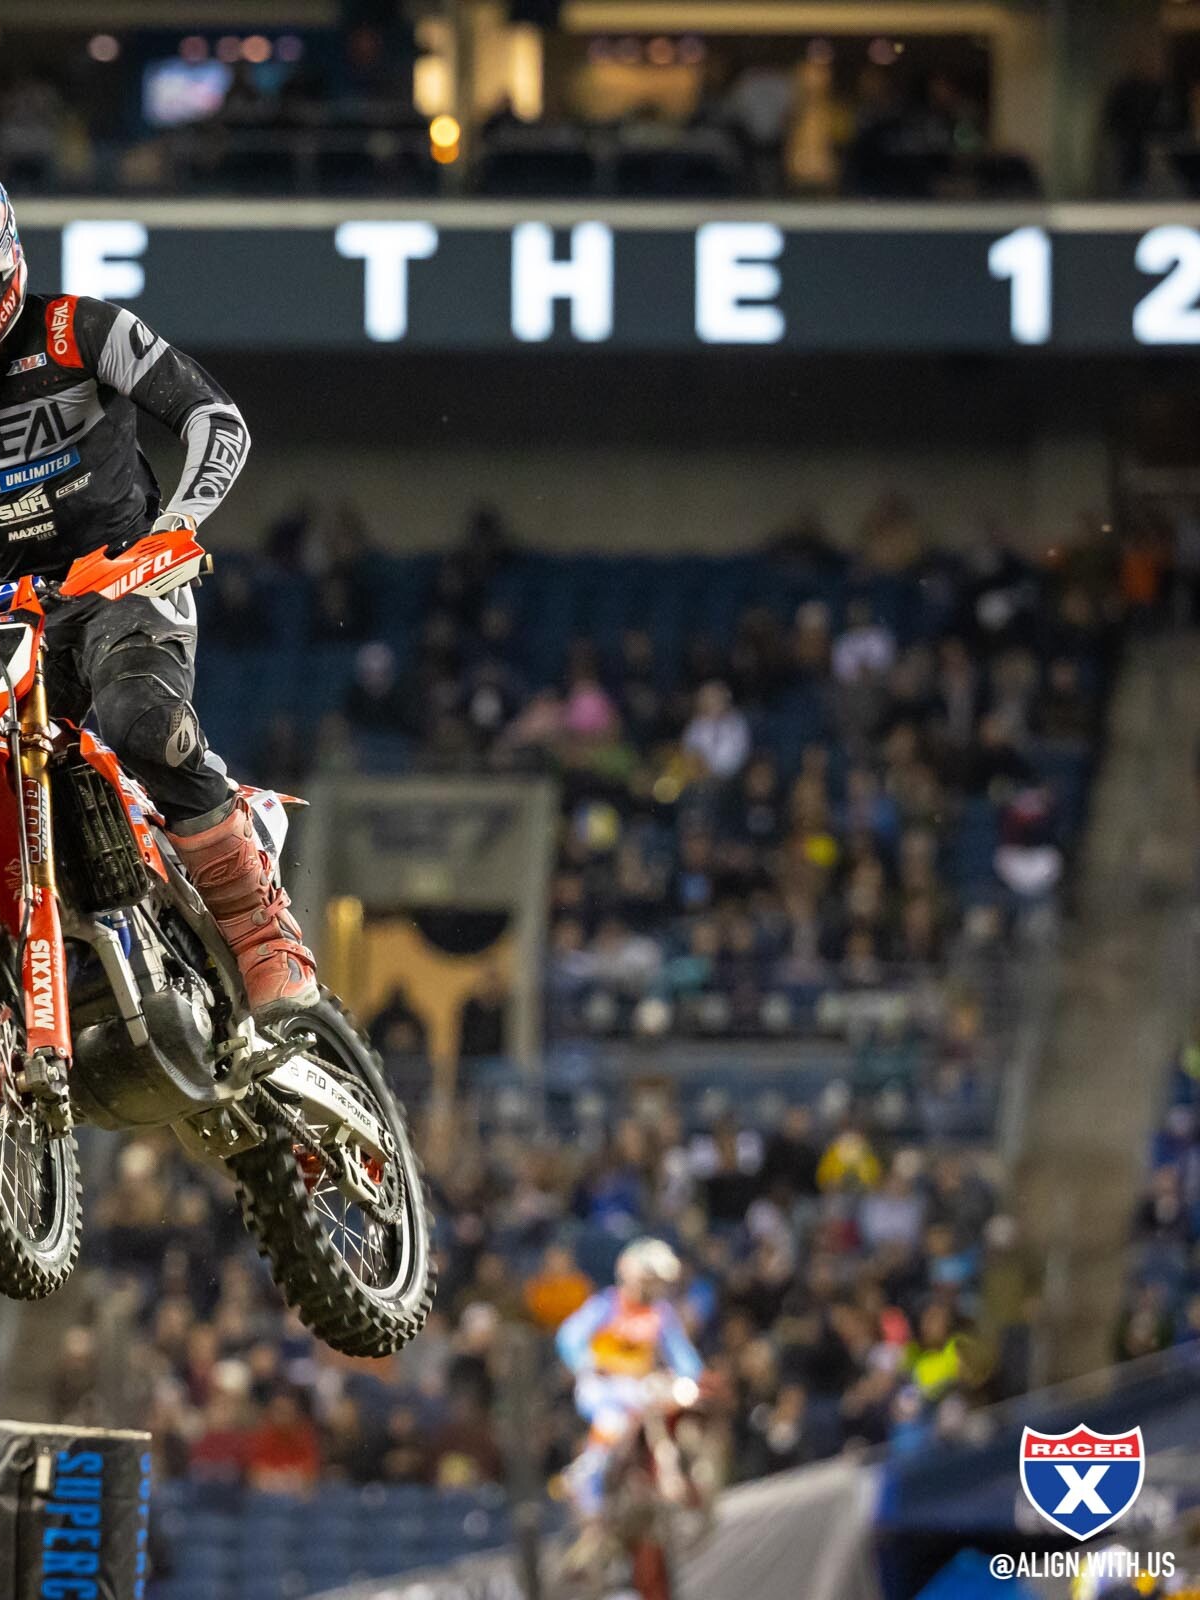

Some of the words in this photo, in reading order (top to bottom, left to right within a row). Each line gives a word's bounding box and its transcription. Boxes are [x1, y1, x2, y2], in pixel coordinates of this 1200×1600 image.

[335, 221, 786, 345] THE
[987, 226, 1200, 347] 12
[9, 353, 47, 376] AMA
[5, 453, 71, 487] UNLIMITED
[8, 521, 55, 542] MAXXIS
[120, 549, 173, 595] UFO
[30, 939, 55, 1031] MAXXIS
[331, 1087, 372, 1128] FIREPOWER
